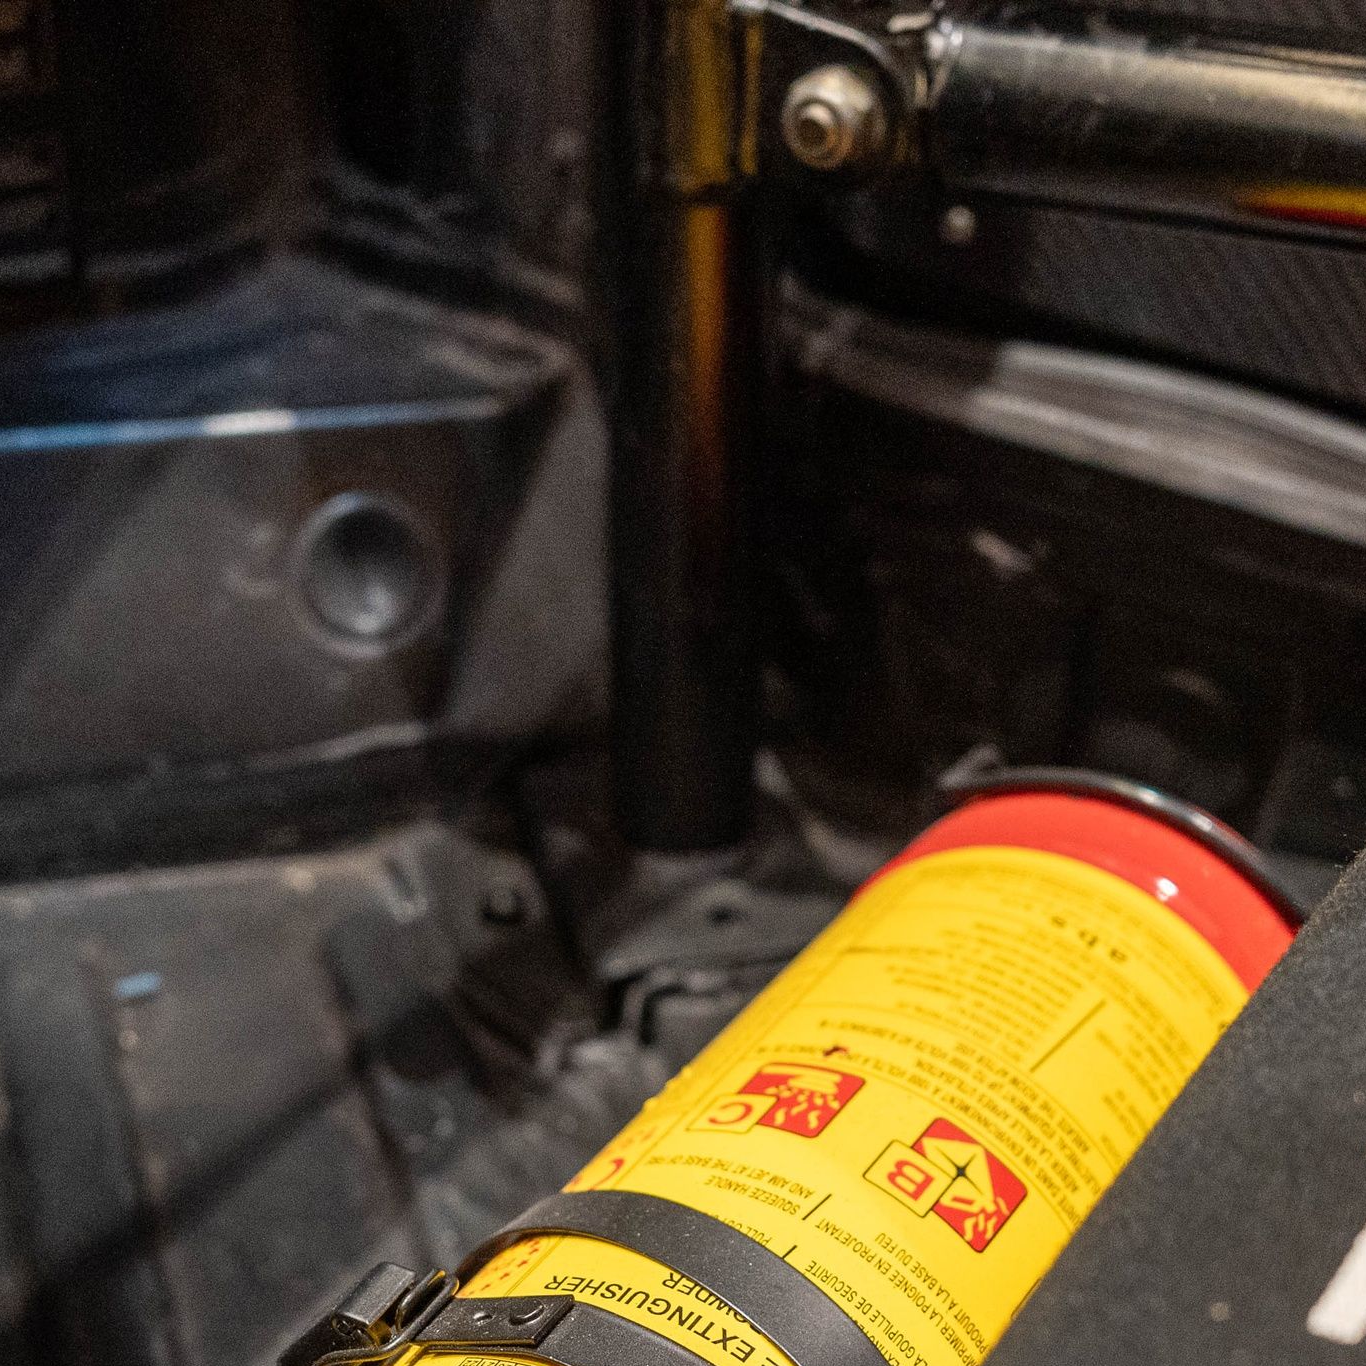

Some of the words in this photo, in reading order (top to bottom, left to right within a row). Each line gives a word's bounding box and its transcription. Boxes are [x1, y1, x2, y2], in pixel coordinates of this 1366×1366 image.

[708, 1102, 751, 1124] C
[887, 1159, 934, 1201] B
[747, 1186, 801, 1215] SQUEEZE
[814, 1218, 877, 1263] PROJETANT
[874, 1232, 898, 1254] FEU
[874, 1257, 892, 1275] EN
[894, 1248, 913, 1267] DU
[909, 1260, 938, 1290] BASE
[853, 1296, 873, 1315] DE
[935, 1285, 950, 1303] LA
[543, 1274, 756, 1363] EXTINGUISHER
[928, 1307, 944, 1327] LA
[868, 1309, 916, 1359] GOUPILLE
[952, 1308, 990, 1355] PRODUIT
